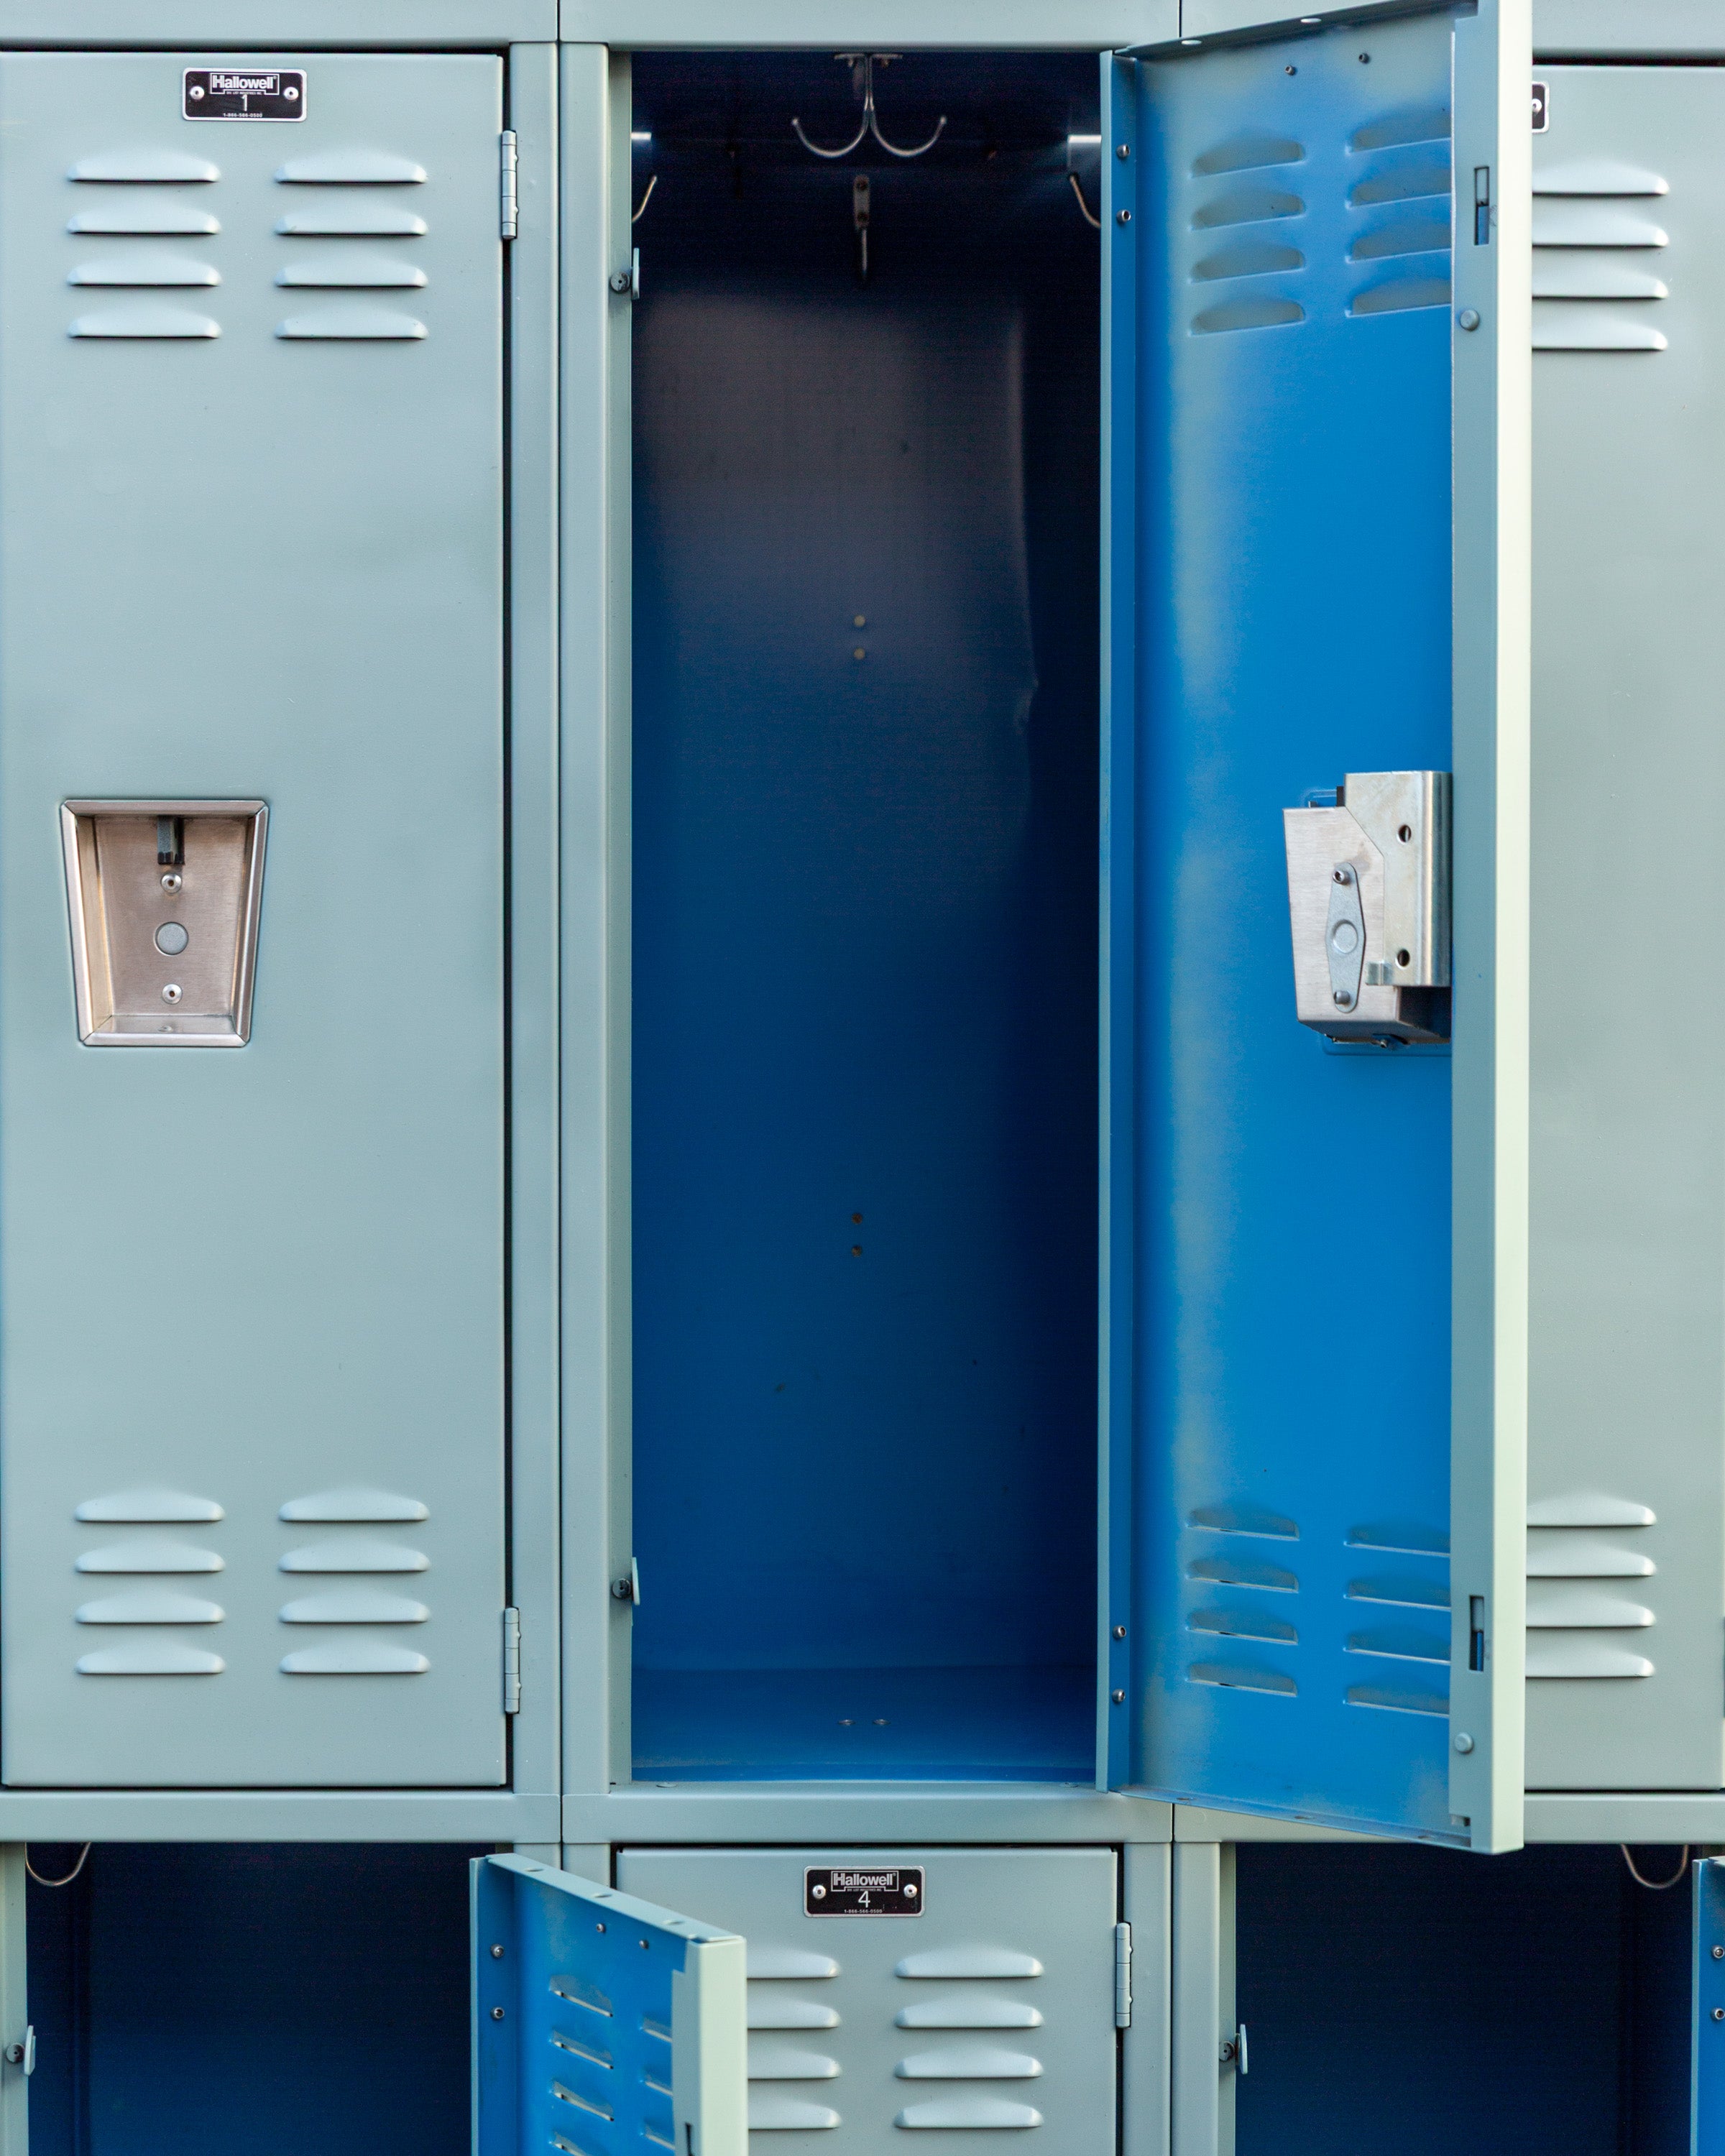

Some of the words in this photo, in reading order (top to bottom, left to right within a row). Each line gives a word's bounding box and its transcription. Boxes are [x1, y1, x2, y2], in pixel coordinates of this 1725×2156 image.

[212, 75, 274, 90] Hallowell
[241, 93, 247, 111] 1
[833, 1872, 893, 1886] Hallowell
[857, 1890, 871, 1908] 4
